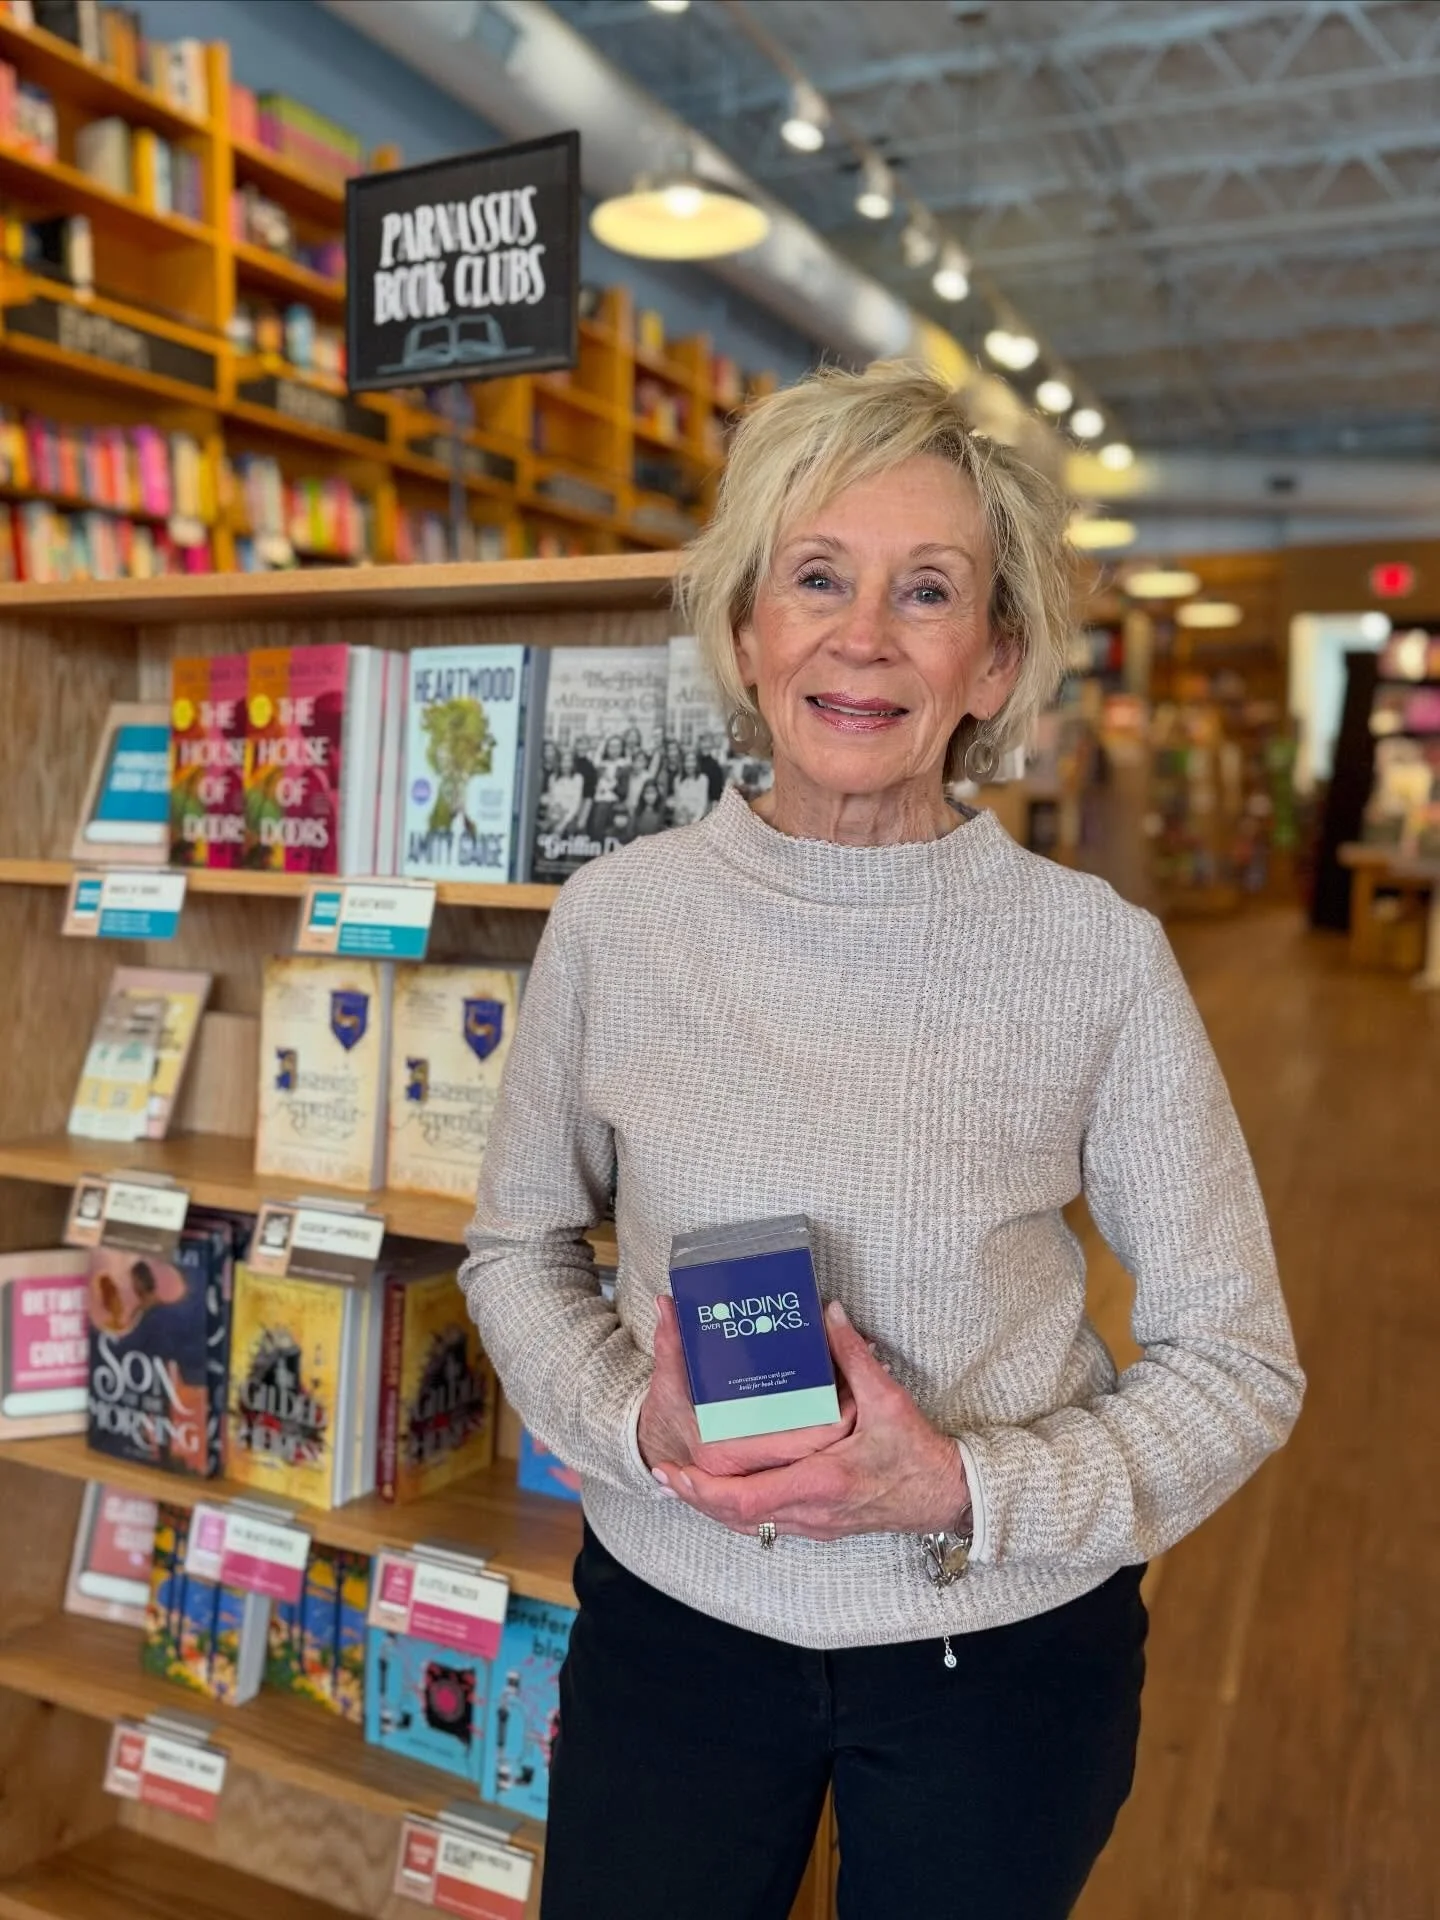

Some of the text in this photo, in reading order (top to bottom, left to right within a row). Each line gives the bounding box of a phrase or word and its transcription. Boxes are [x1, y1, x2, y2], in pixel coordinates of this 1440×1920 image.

[380, 186, 538, 268] PARNASSUS
[374, 244, 546, 326] BOOK CLUBS
[414, 667, 516, 703] HEARTWOOD
[200, 699, 237, 730] THE
[277, 696, 315, 727] THE
[257, 736, 329, 767] HOUSE
[198, 776, 232, 805] OF
[275, 776, 309, 808] OF
[260, 816, 329, 849] DOORS
[536, 832, 602, 860] Griffin
[407, 831, 507, 868] AMITY GAIGE
[698, 1291, 800, 1324] BONDING
[701, 1322, 721, 1331] OVER
[723, 1310, 803, 1339] BOOKS
[761, 1379, 774, 1388] book
